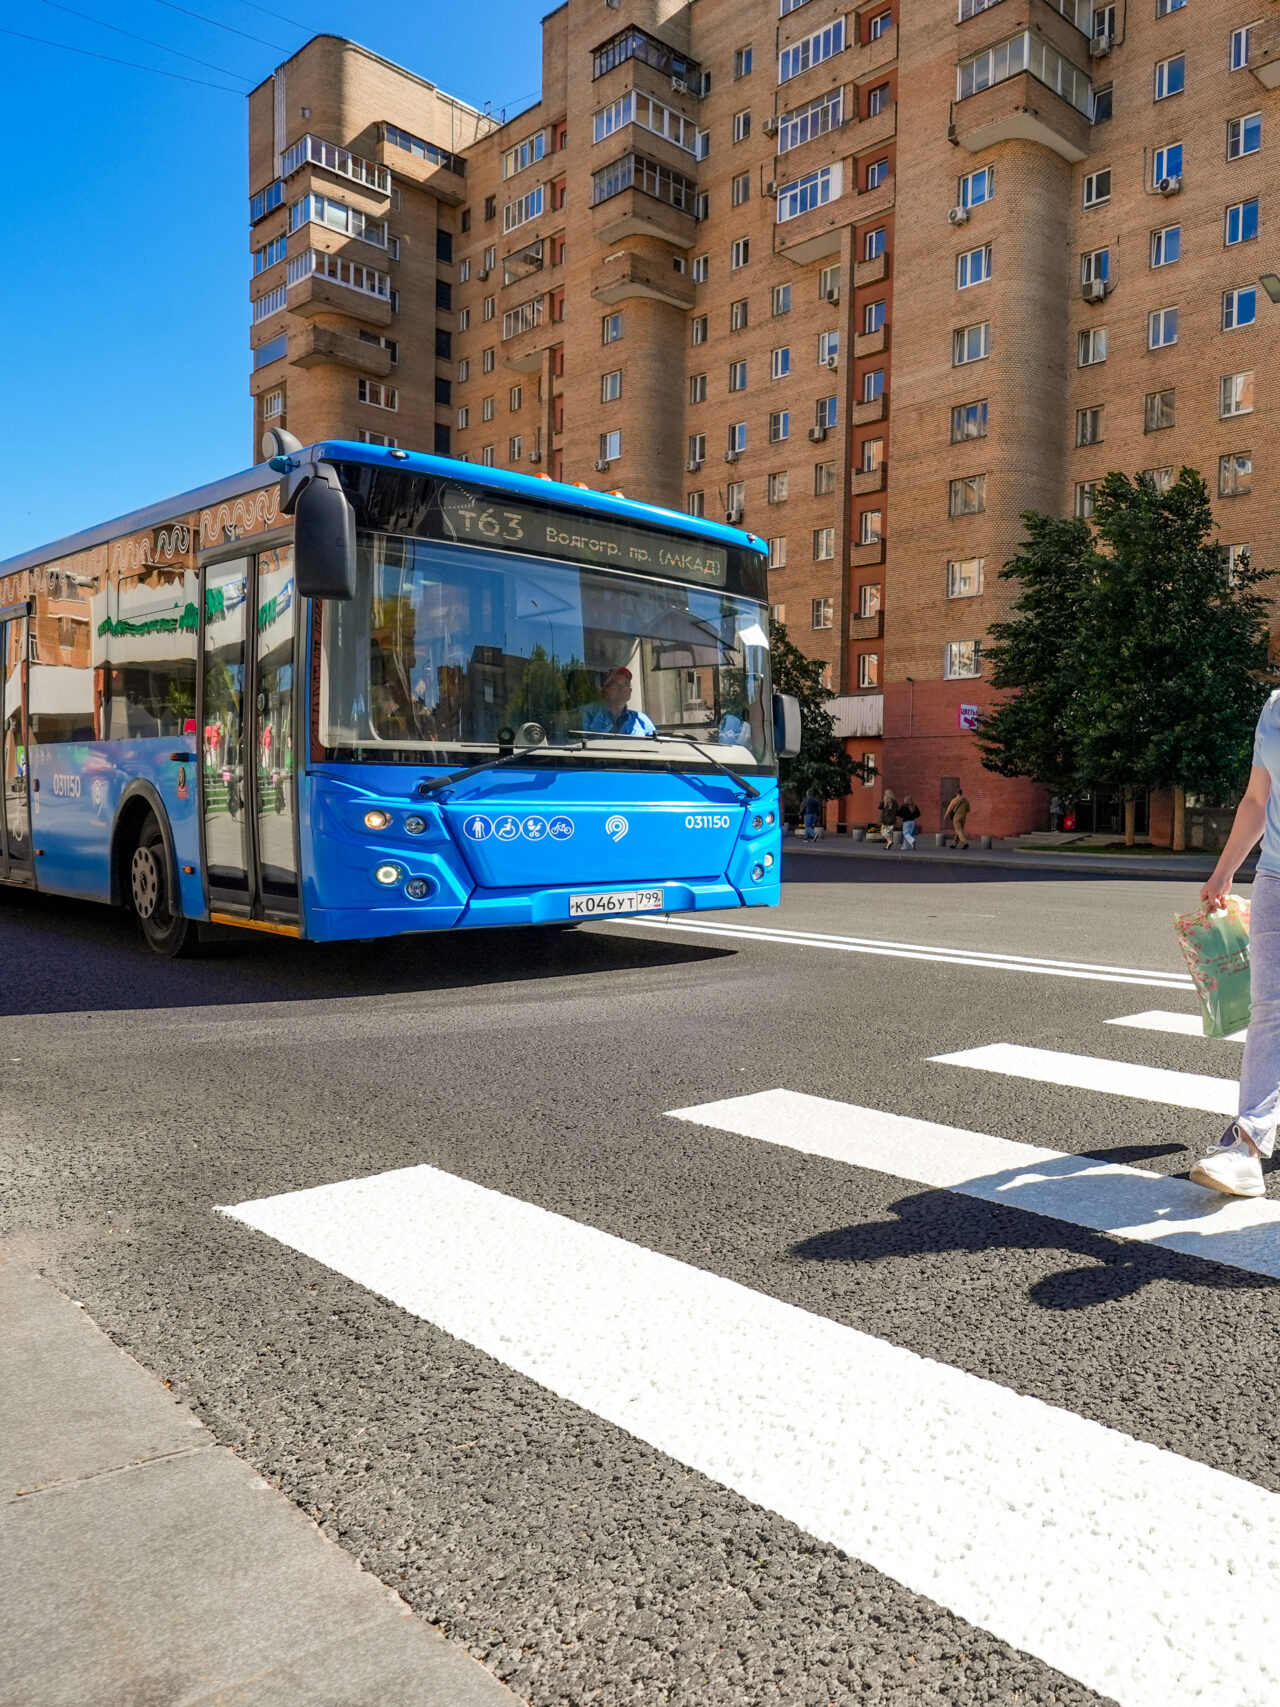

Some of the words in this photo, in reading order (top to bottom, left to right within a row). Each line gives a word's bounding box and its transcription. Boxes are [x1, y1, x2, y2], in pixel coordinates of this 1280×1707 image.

[546, 527, 622, 556] Волгогр.
[629, 547, 652, 561] пр.
[659, 549, 721, 576] (МКАД)
[53, 773, 81, 798] 031150
[685, 815, 730, 828] 031150
[575, 896, 635, 913] К046УТ
[638, 892, 659, 905] 799
